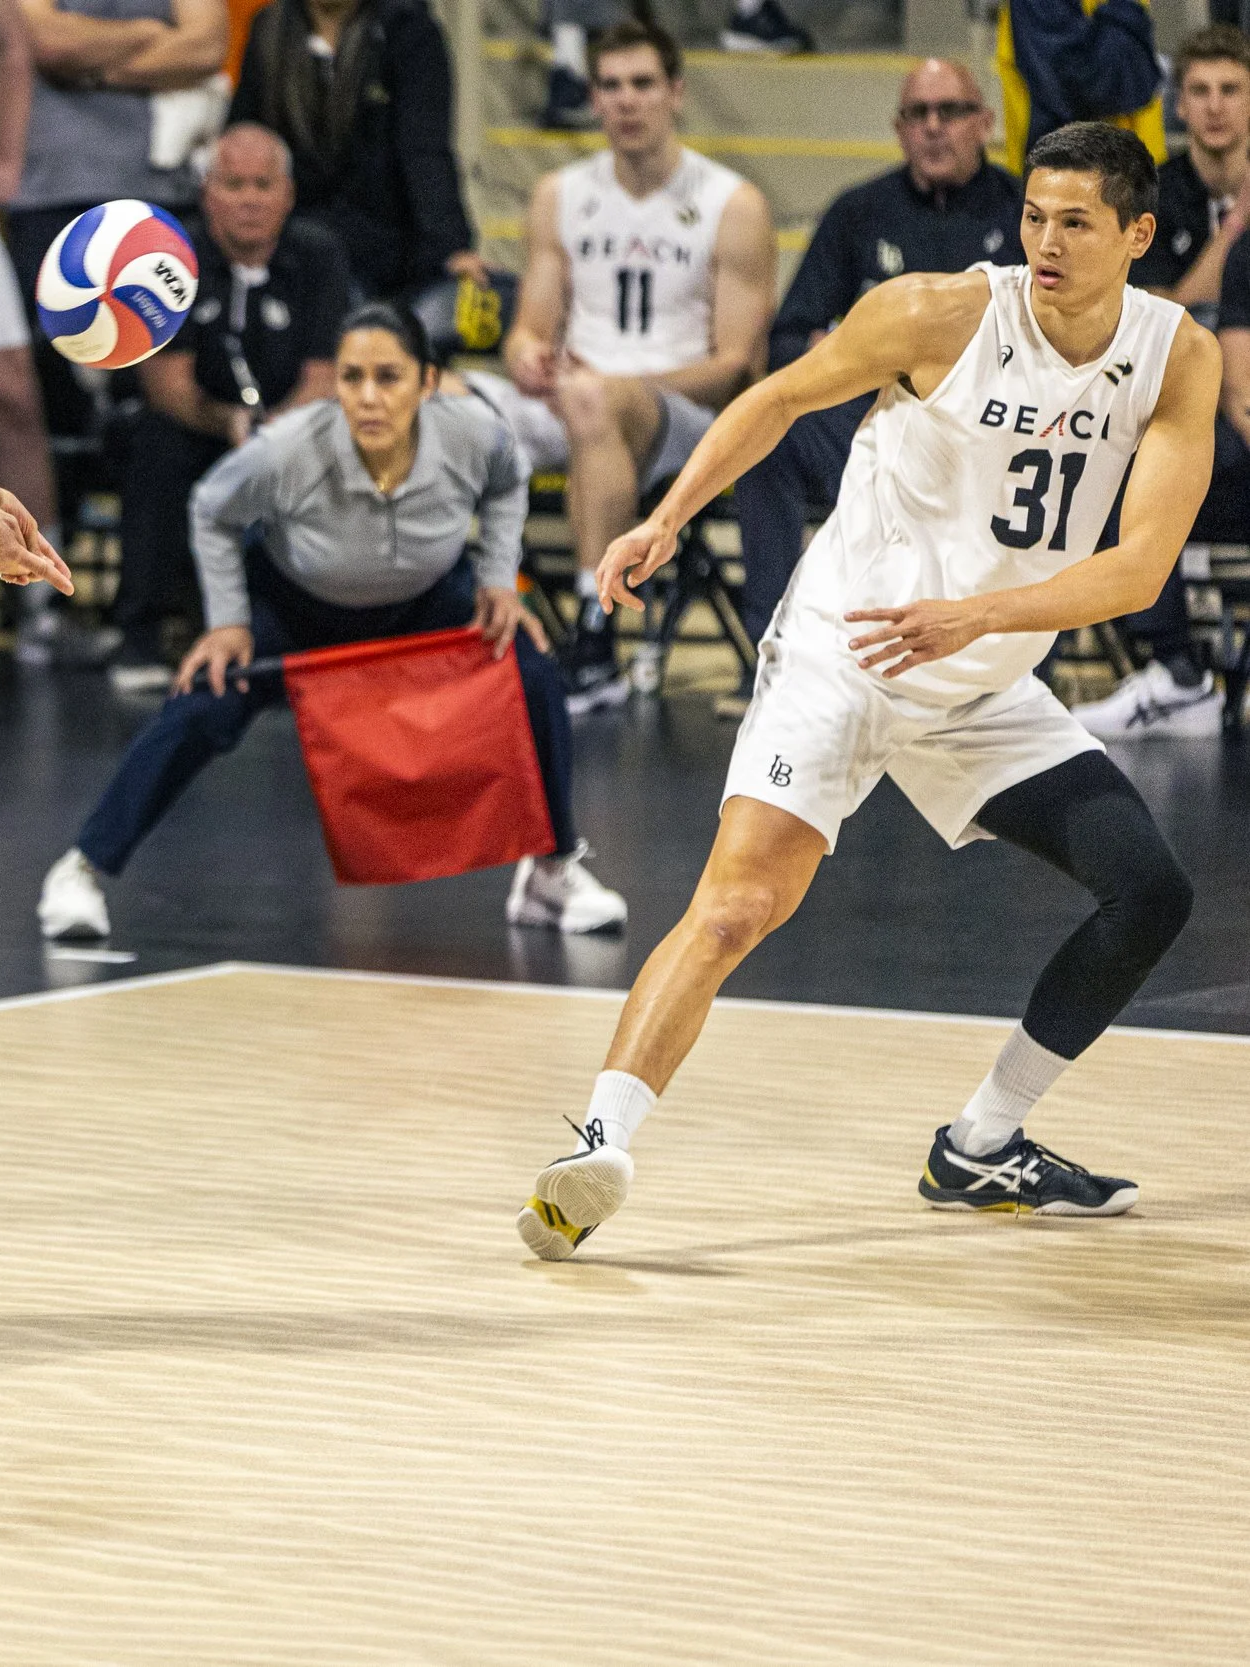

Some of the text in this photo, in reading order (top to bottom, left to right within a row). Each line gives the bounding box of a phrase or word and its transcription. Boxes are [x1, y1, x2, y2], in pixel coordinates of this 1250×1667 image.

[579, 236, 691, 265] BEACH
[616, 267, 654, 333] 11
[990, 448, 1088, 552] 31
